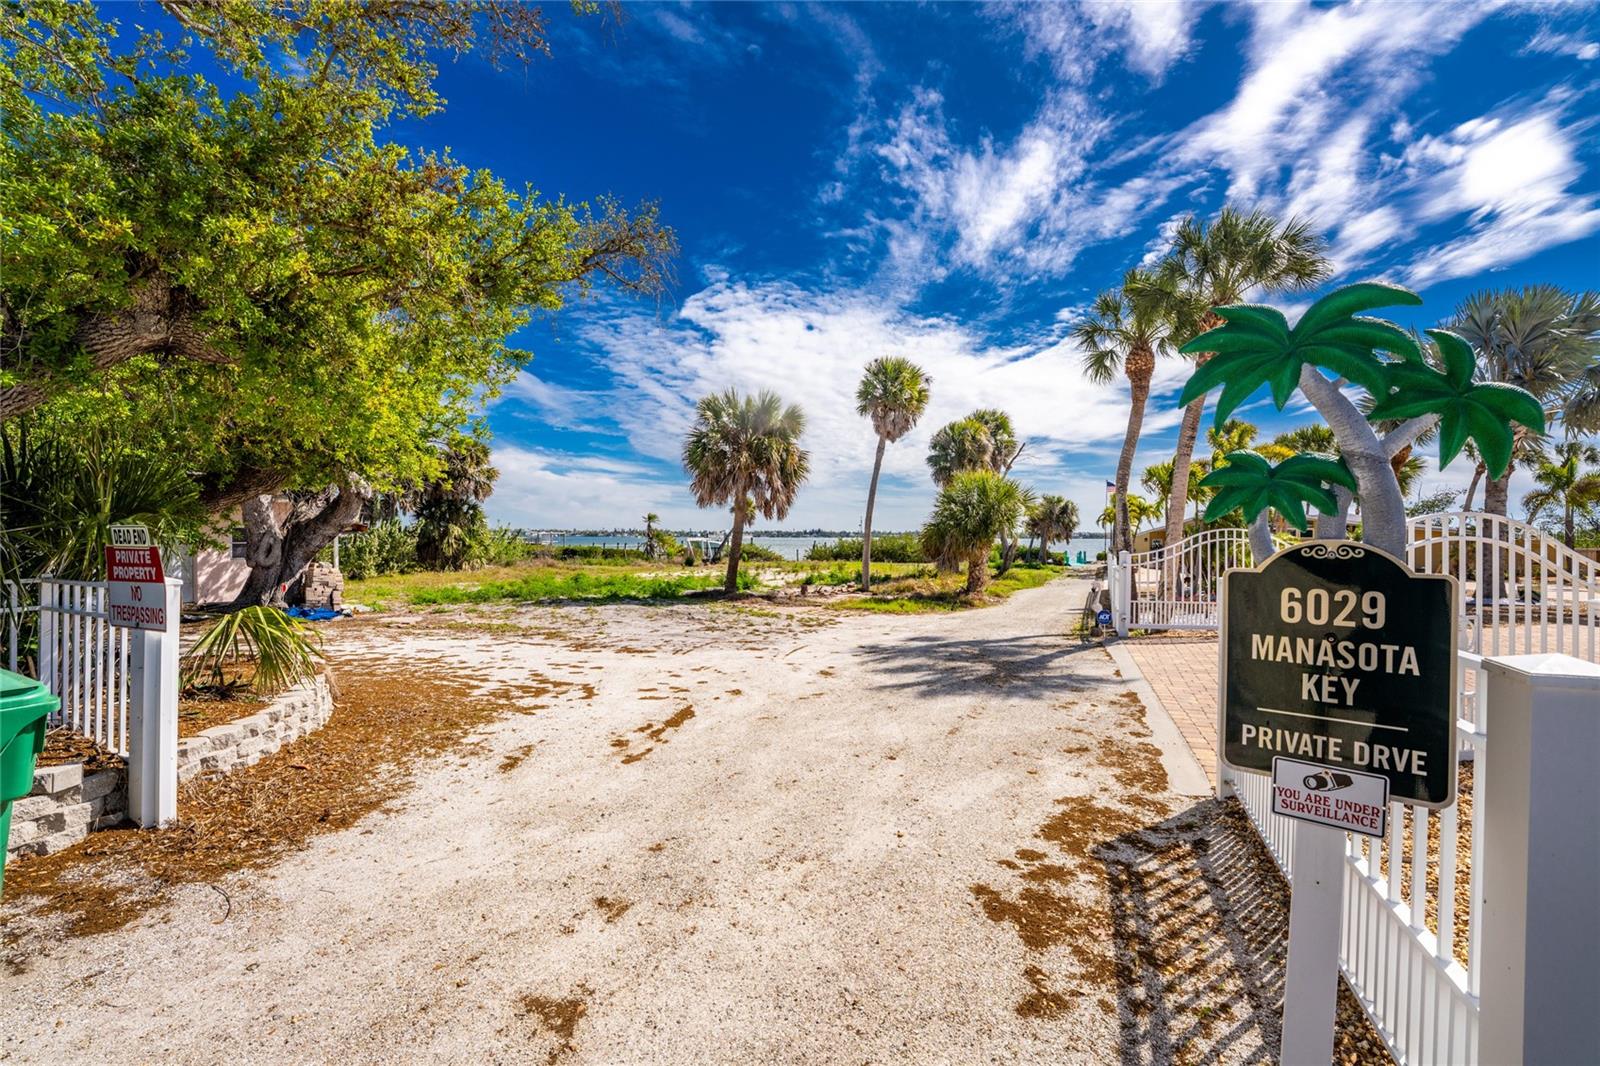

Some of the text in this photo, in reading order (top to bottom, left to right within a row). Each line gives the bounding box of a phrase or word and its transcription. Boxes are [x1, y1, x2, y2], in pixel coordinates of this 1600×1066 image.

[113, 529, 147, 545] DEAD END
[113, 566, 156, 580] PROPERTY
[115, 550, 151, 564] PRIVATE
[130, 585, 142, 601] NO
[1280, 587, 1386, 630] 6029
[111, 604, 164, 625] TRESPASSING
[1251, 633, 1421, 677] MANASOTA
[1301, 672, 1361, 706] KEY
[1241, 723, 1428, 777] PRIVATE DRVE
[1276, 786, 1380, 818] YOU ARE UNDER
[1280, 798, 1379, 830] SURVEILLANCE
